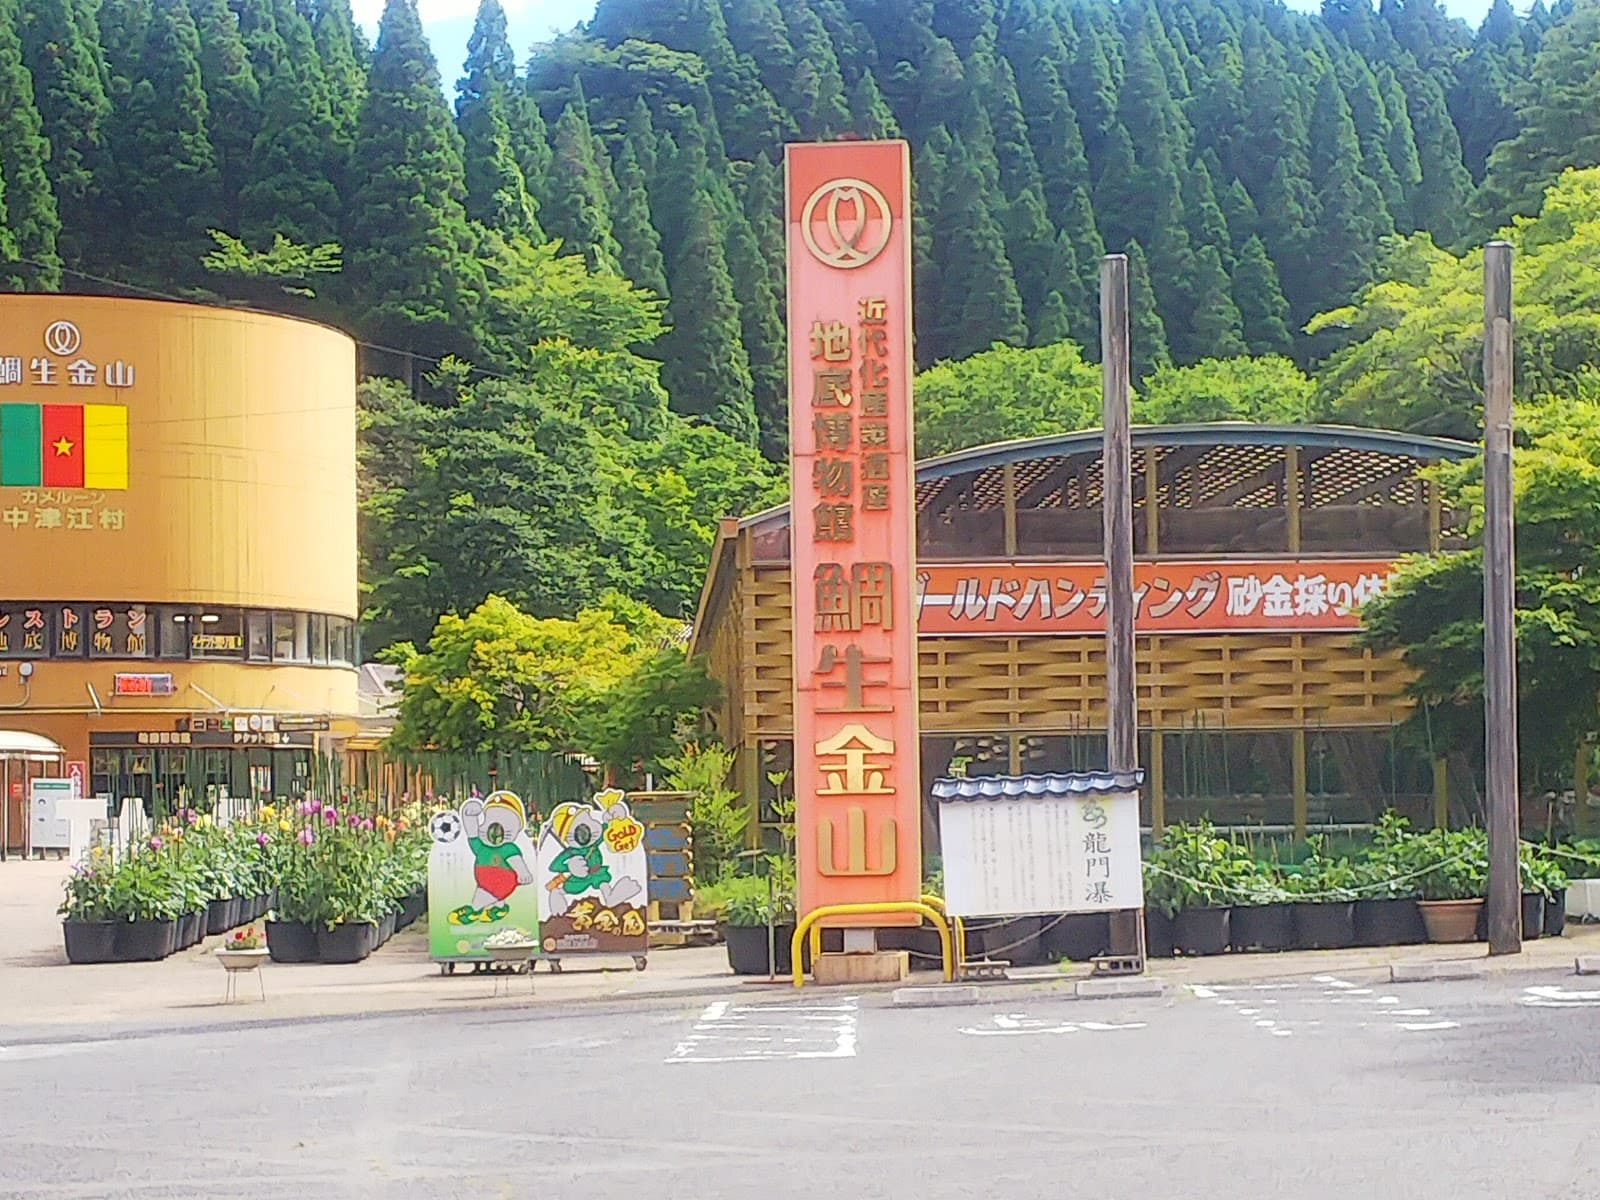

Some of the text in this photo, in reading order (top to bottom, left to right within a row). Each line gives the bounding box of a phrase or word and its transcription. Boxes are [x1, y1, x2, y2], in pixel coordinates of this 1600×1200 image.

[810, 320, 854, 543] 地底博物館
[858, 297, 890, 511] 近代化産業遺産
[3, 507, 125, 529] 中津江村
[21, 490, 106, 505] カメルーン
[1226, 571, 1395, 618] 砂金採り体
[812, 561, 897, 876] 鯛生金山
